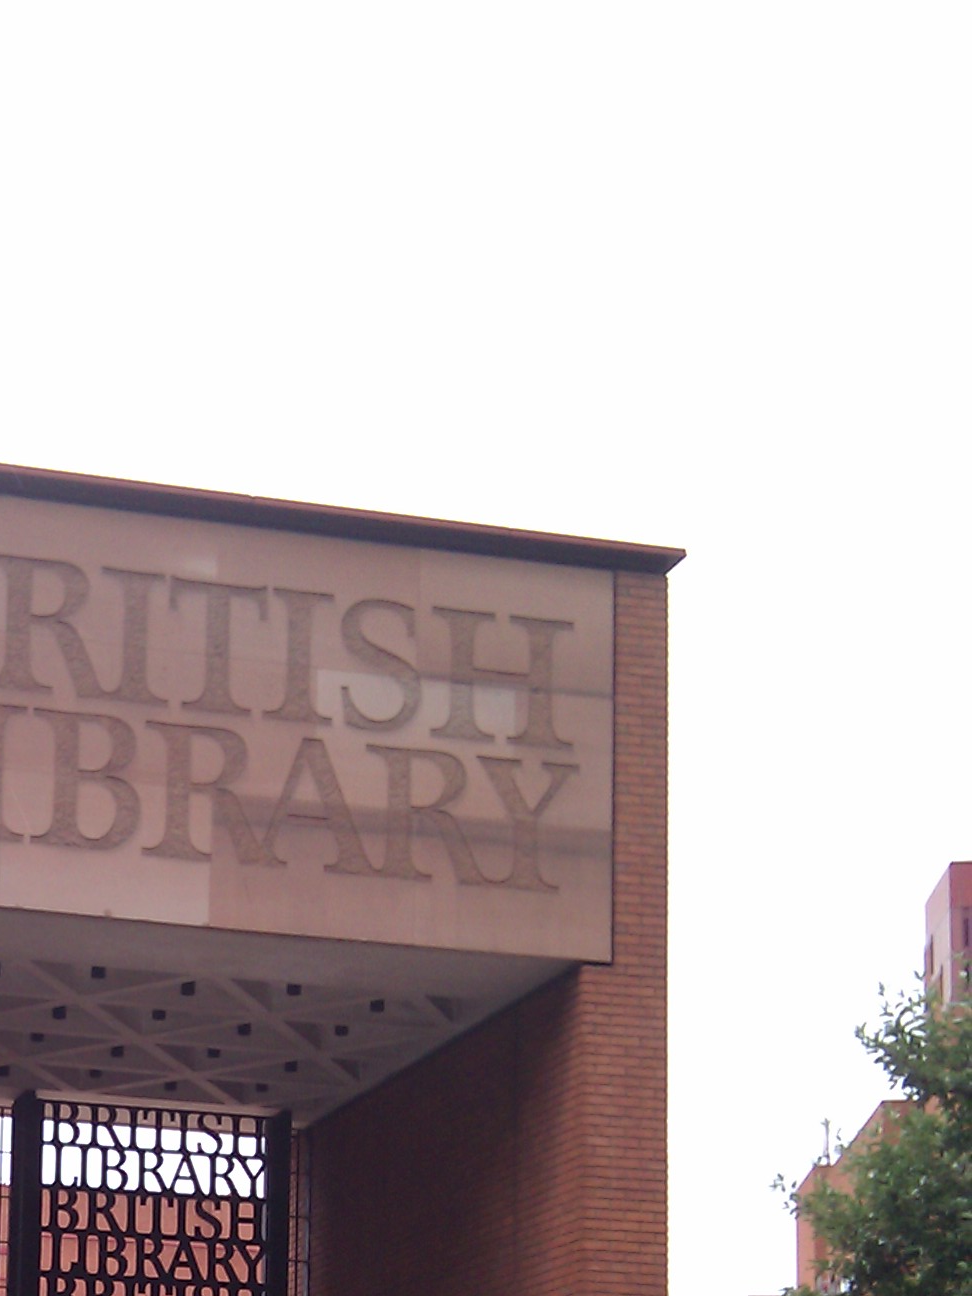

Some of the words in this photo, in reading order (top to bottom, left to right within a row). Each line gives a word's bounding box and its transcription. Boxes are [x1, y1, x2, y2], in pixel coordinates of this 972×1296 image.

[47, 1102, 267, 1158] BRITISH
[46, 1143, 267, 1199] LIBRARY
[46, 1188, 266, 1241] BRITISH
[45, 1231, 265, 1285] LIBRARY
